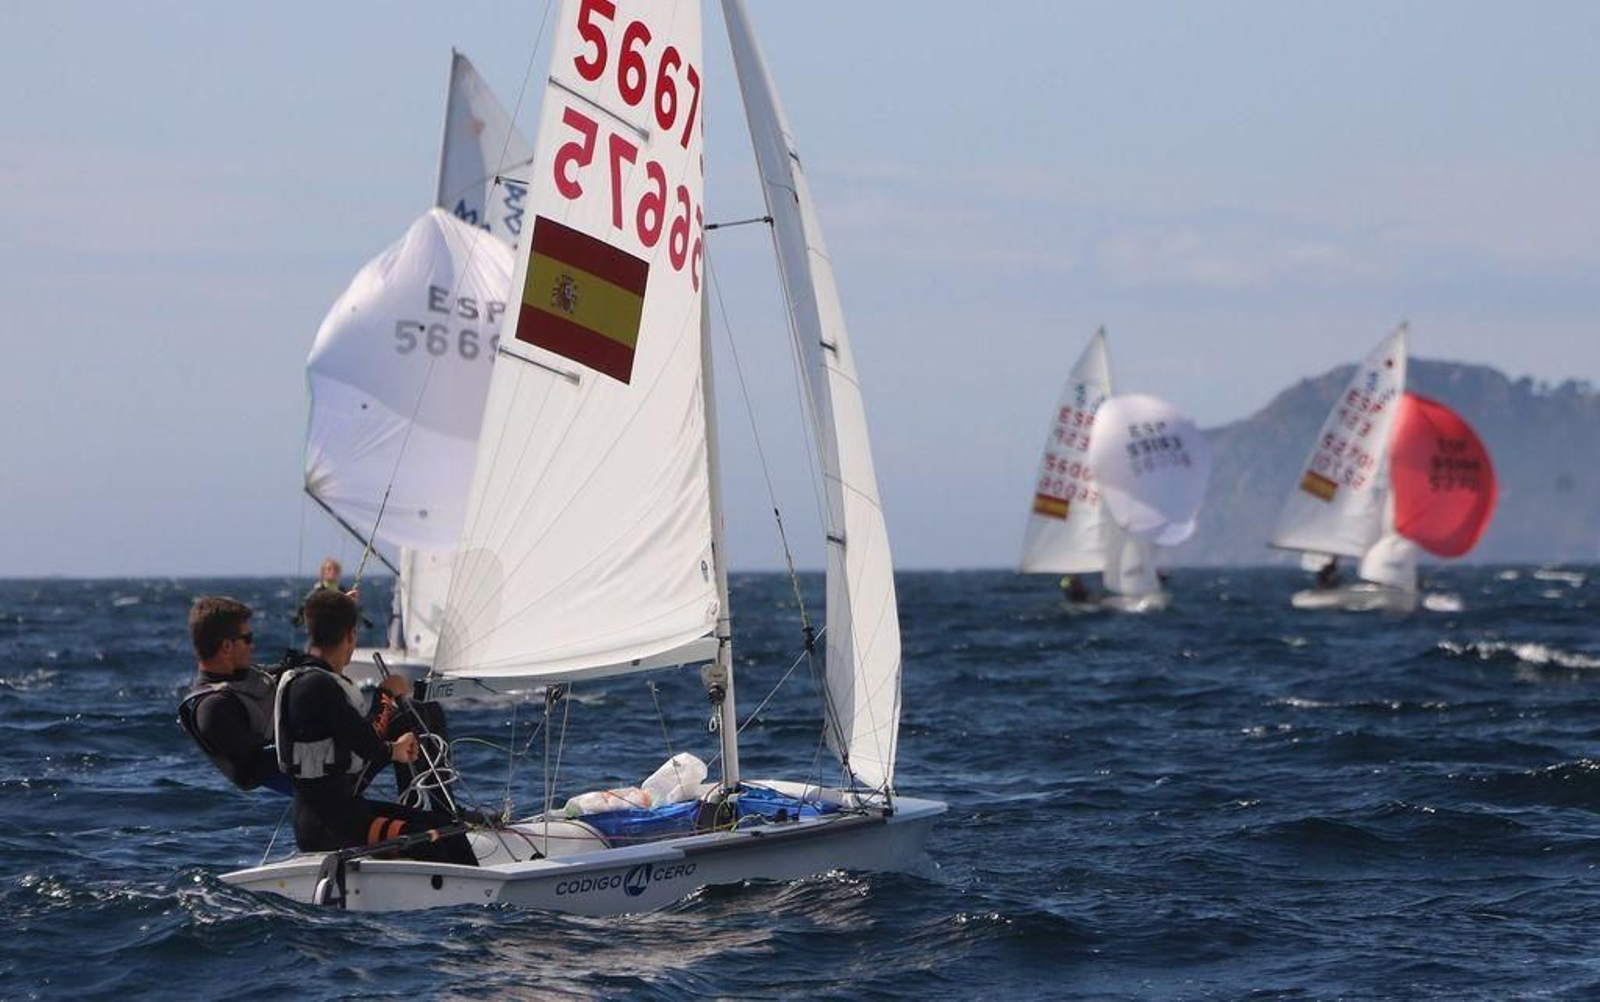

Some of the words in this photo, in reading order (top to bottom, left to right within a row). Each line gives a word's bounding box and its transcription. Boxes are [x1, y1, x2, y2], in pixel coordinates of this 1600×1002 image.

[574, 0, 703, 162] 5667
[427, 285, 506, 323] ESP
[556, 874, 622, 896] CODIGO
[653, 863, 697, 881] CERO
